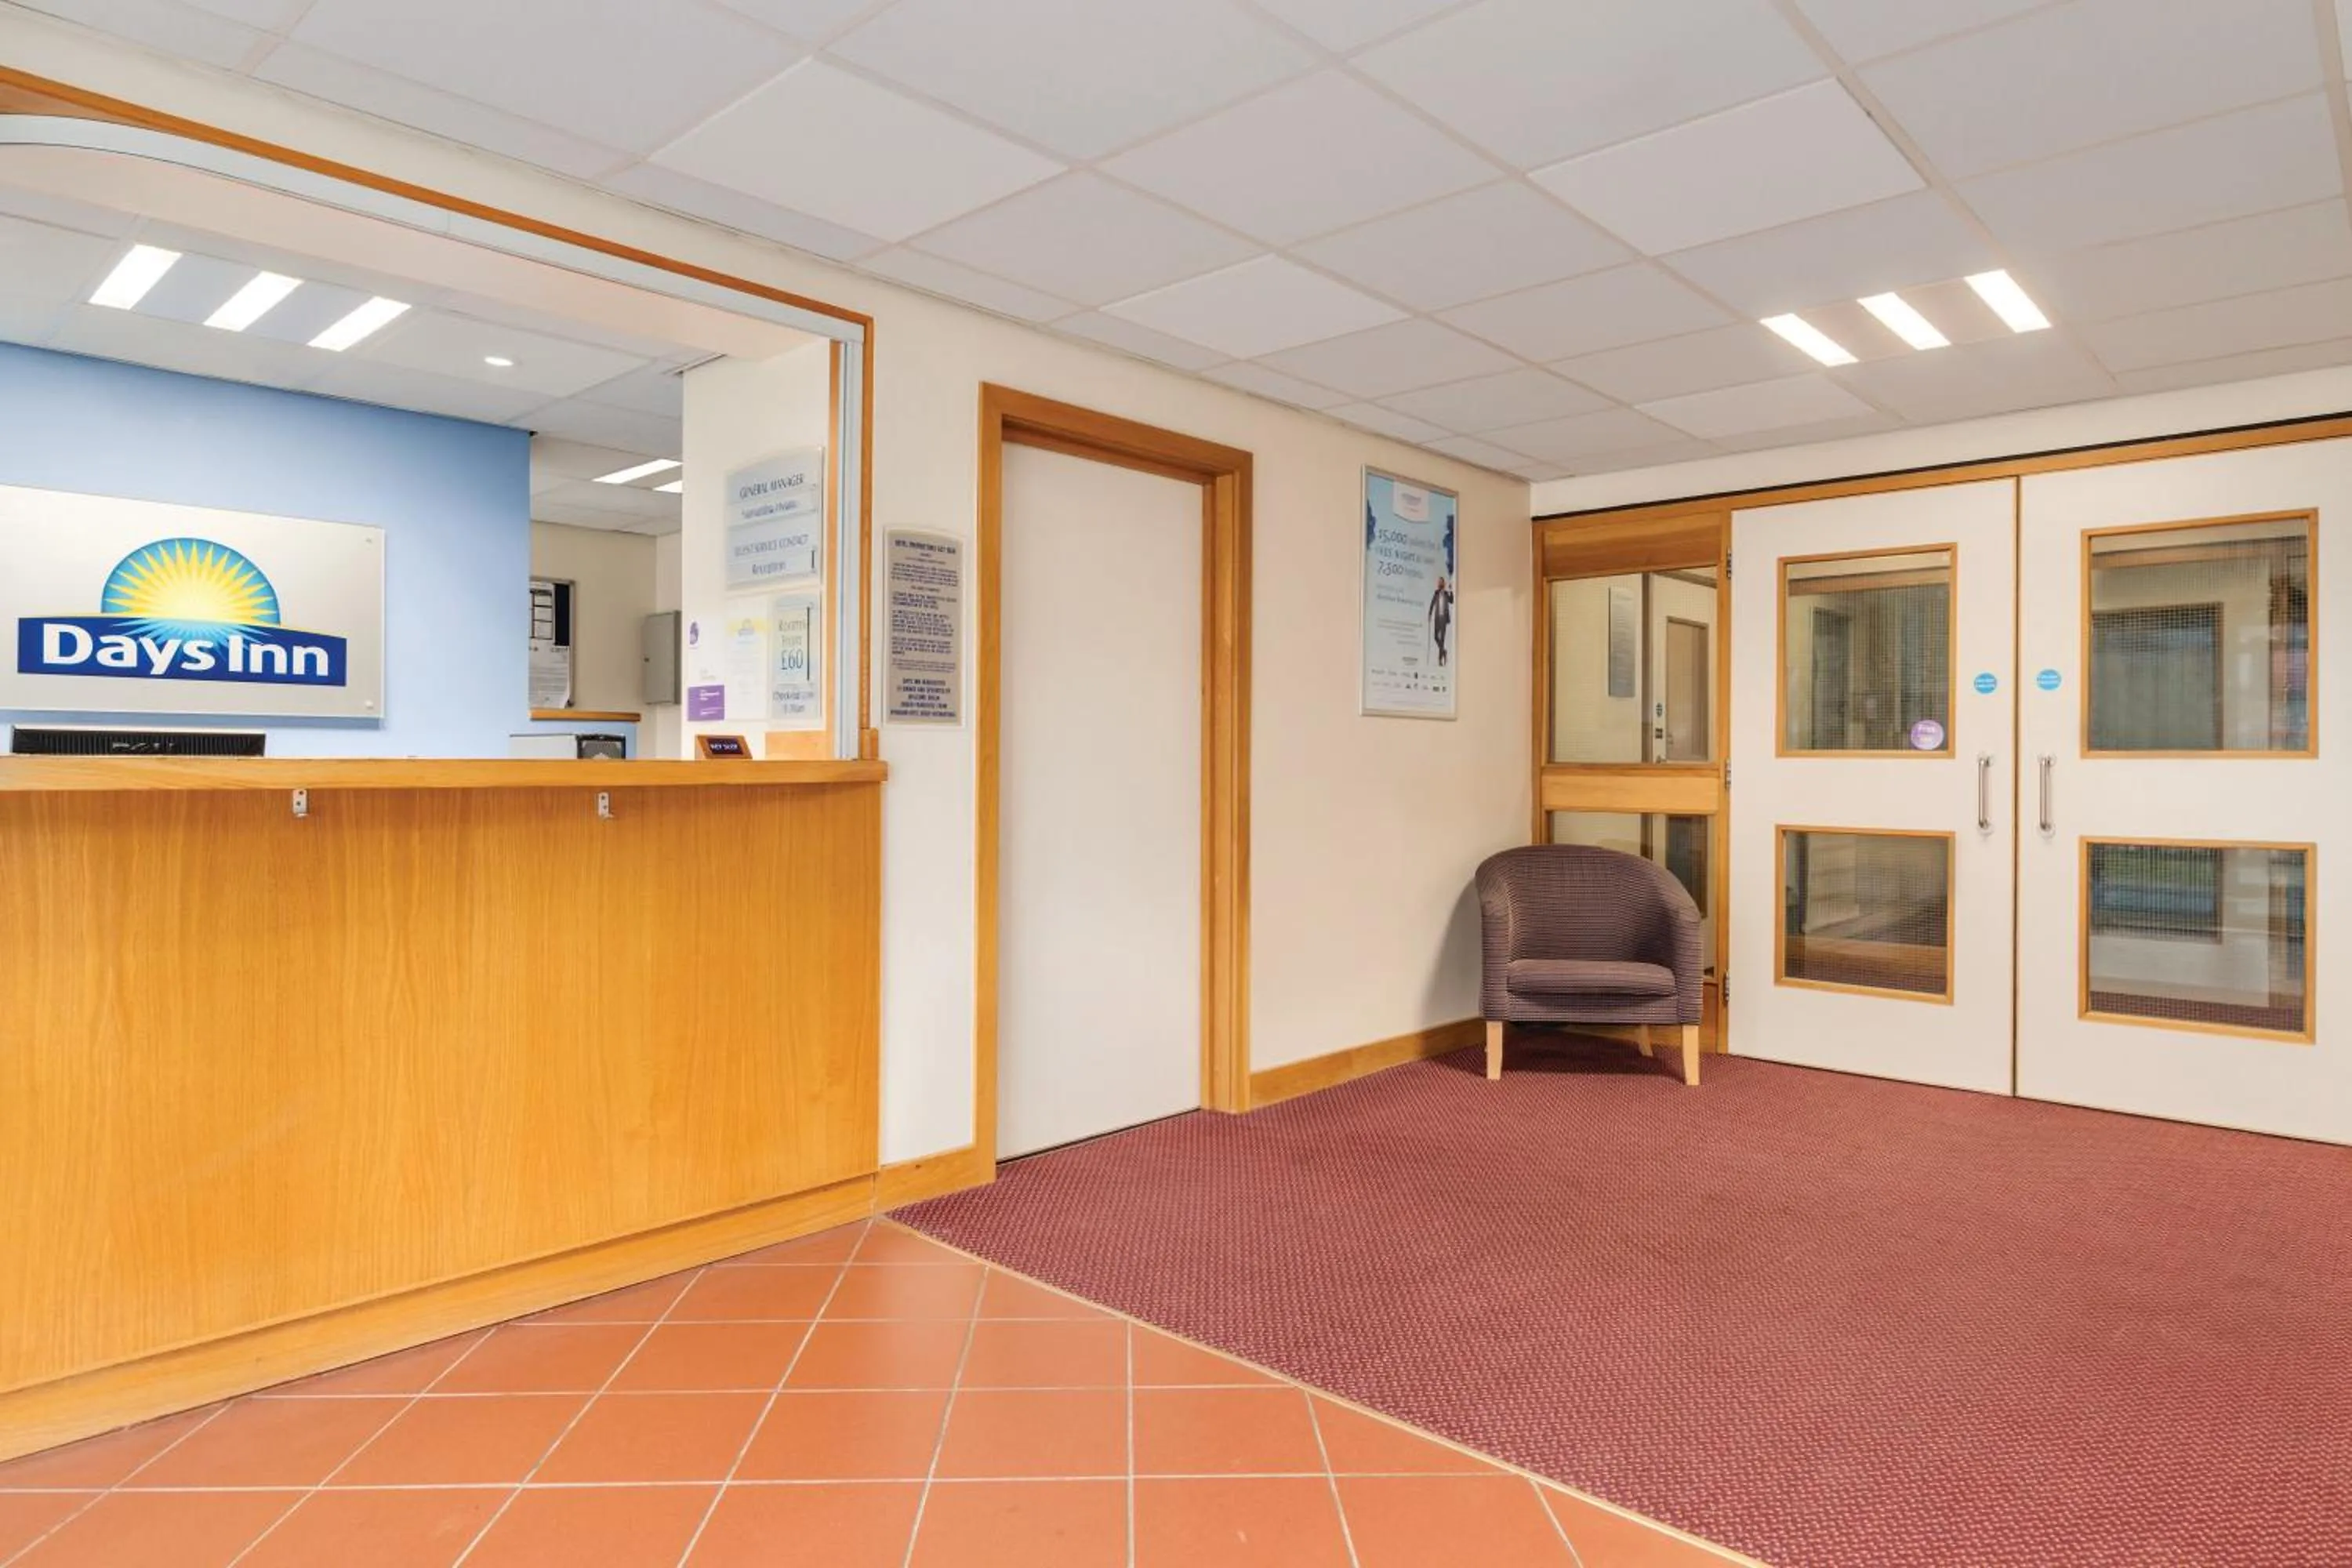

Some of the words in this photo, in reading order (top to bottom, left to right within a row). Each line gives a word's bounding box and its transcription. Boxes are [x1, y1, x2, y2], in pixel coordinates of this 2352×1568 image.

[739, 482, 768, 499] GENERAL
[771, 474, 804, 491] MANAGER
[43, 623, 214, 674] Days
[228, 636, 328, 677] Inn
[781, 648, 804, 670] £60
